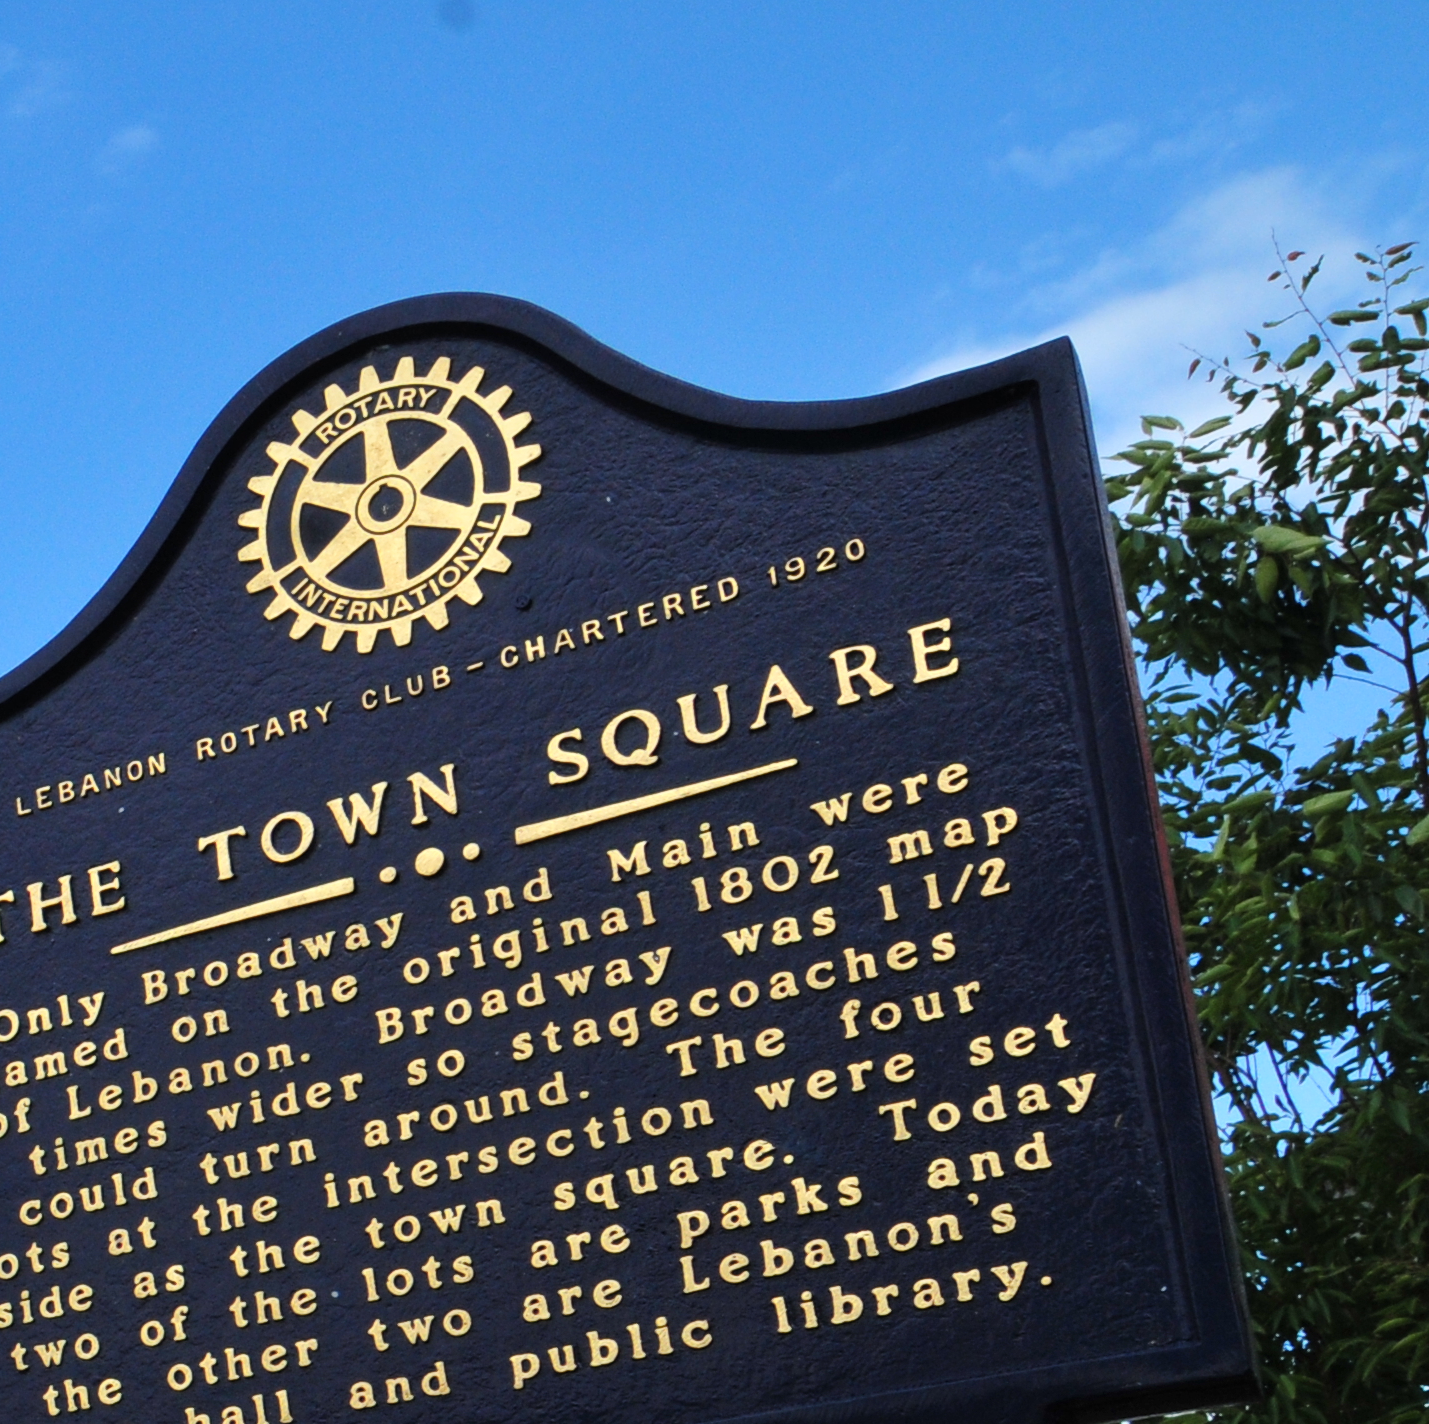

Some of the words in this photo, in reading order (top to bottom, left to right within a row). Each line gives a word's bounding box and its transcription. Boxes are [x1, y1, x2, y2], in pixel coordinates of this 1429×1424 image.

[314, 386, 438, 445] ROTARY
[14, 751, 167, 817] LEBANON
[194, 701, 332, 762] ROTARY
[767, 537, 866, 587] 1920
[290, 513, 502, 623] INTERNATIONAL
[196, 762, 459, 882] TOWN
[545, 616, 960, 787] SQUARE
[139, 911, 404, 1006] Broadway
[448, 866, 554, 925] and
[605, 820, 761, 883] Main
[809, 761, 970, 827] were
[170, 1007, 231, 1044] on
[269, 973, 359, 1019] the
[401, 889, 657, 985] original
[689, 843, 841, 913] 1802
[885, 805, 1019, 865] map
[17, 1165, 159, 1227] could
[197, 1137, 317, 1186] turn
[362, 1069, 591, 1149] around.
[664, 1026, 787, 1078] The
[838, 979, 982, 1040] four
[27, 1118, 168, 1177] times
[205, 1071, 364, 1133] wider
[405, 1048, 467, 1087] so
[510, 930, 957, 1062] stagecoaches
[64, 1042, 311, 1122] Lebanon.
[373, 944, 673, 1046] Broadway
[720, 905, 838, 957] was
[106, 1215, 157, 1257] at
[190, 1194, 279, 1237] the
[322, 1097, 715, 1209] intersection
[753, 1052, 916, 1112] were
[968, 1011, 1072, 1068] set
[9, 1331, 101, 1372] two
[138, 1304, 190, 1348] of
[227, 1287, 318, 1329] the
[360, 1254, 475, 1303] lots
[529, 1222, 632, 1270] are
[675, 1174, 864, 1250] parks
[925, 1129, 1054, 1191] and
[132, 1263, 186, 1300] as
[227, 1234, 321, 1279] the
[363, 1197, 507, 1250] town
[552, 1138, 795, 1212] square.
[877, 1071, 1098, 1142] Today
[41, 1376, 123, 1418] the
[165, 1337, 319, 1392] other
[366, 1307, 473, 1353] two
[521, 1278, 624, 1324] are
[678, 1201, 1018, 1295] Lebanon's
[347, 1359, 452, 1411] and
[507, 1315, 714, 1391] public
[769, 1259, 1053, 1334] library.
